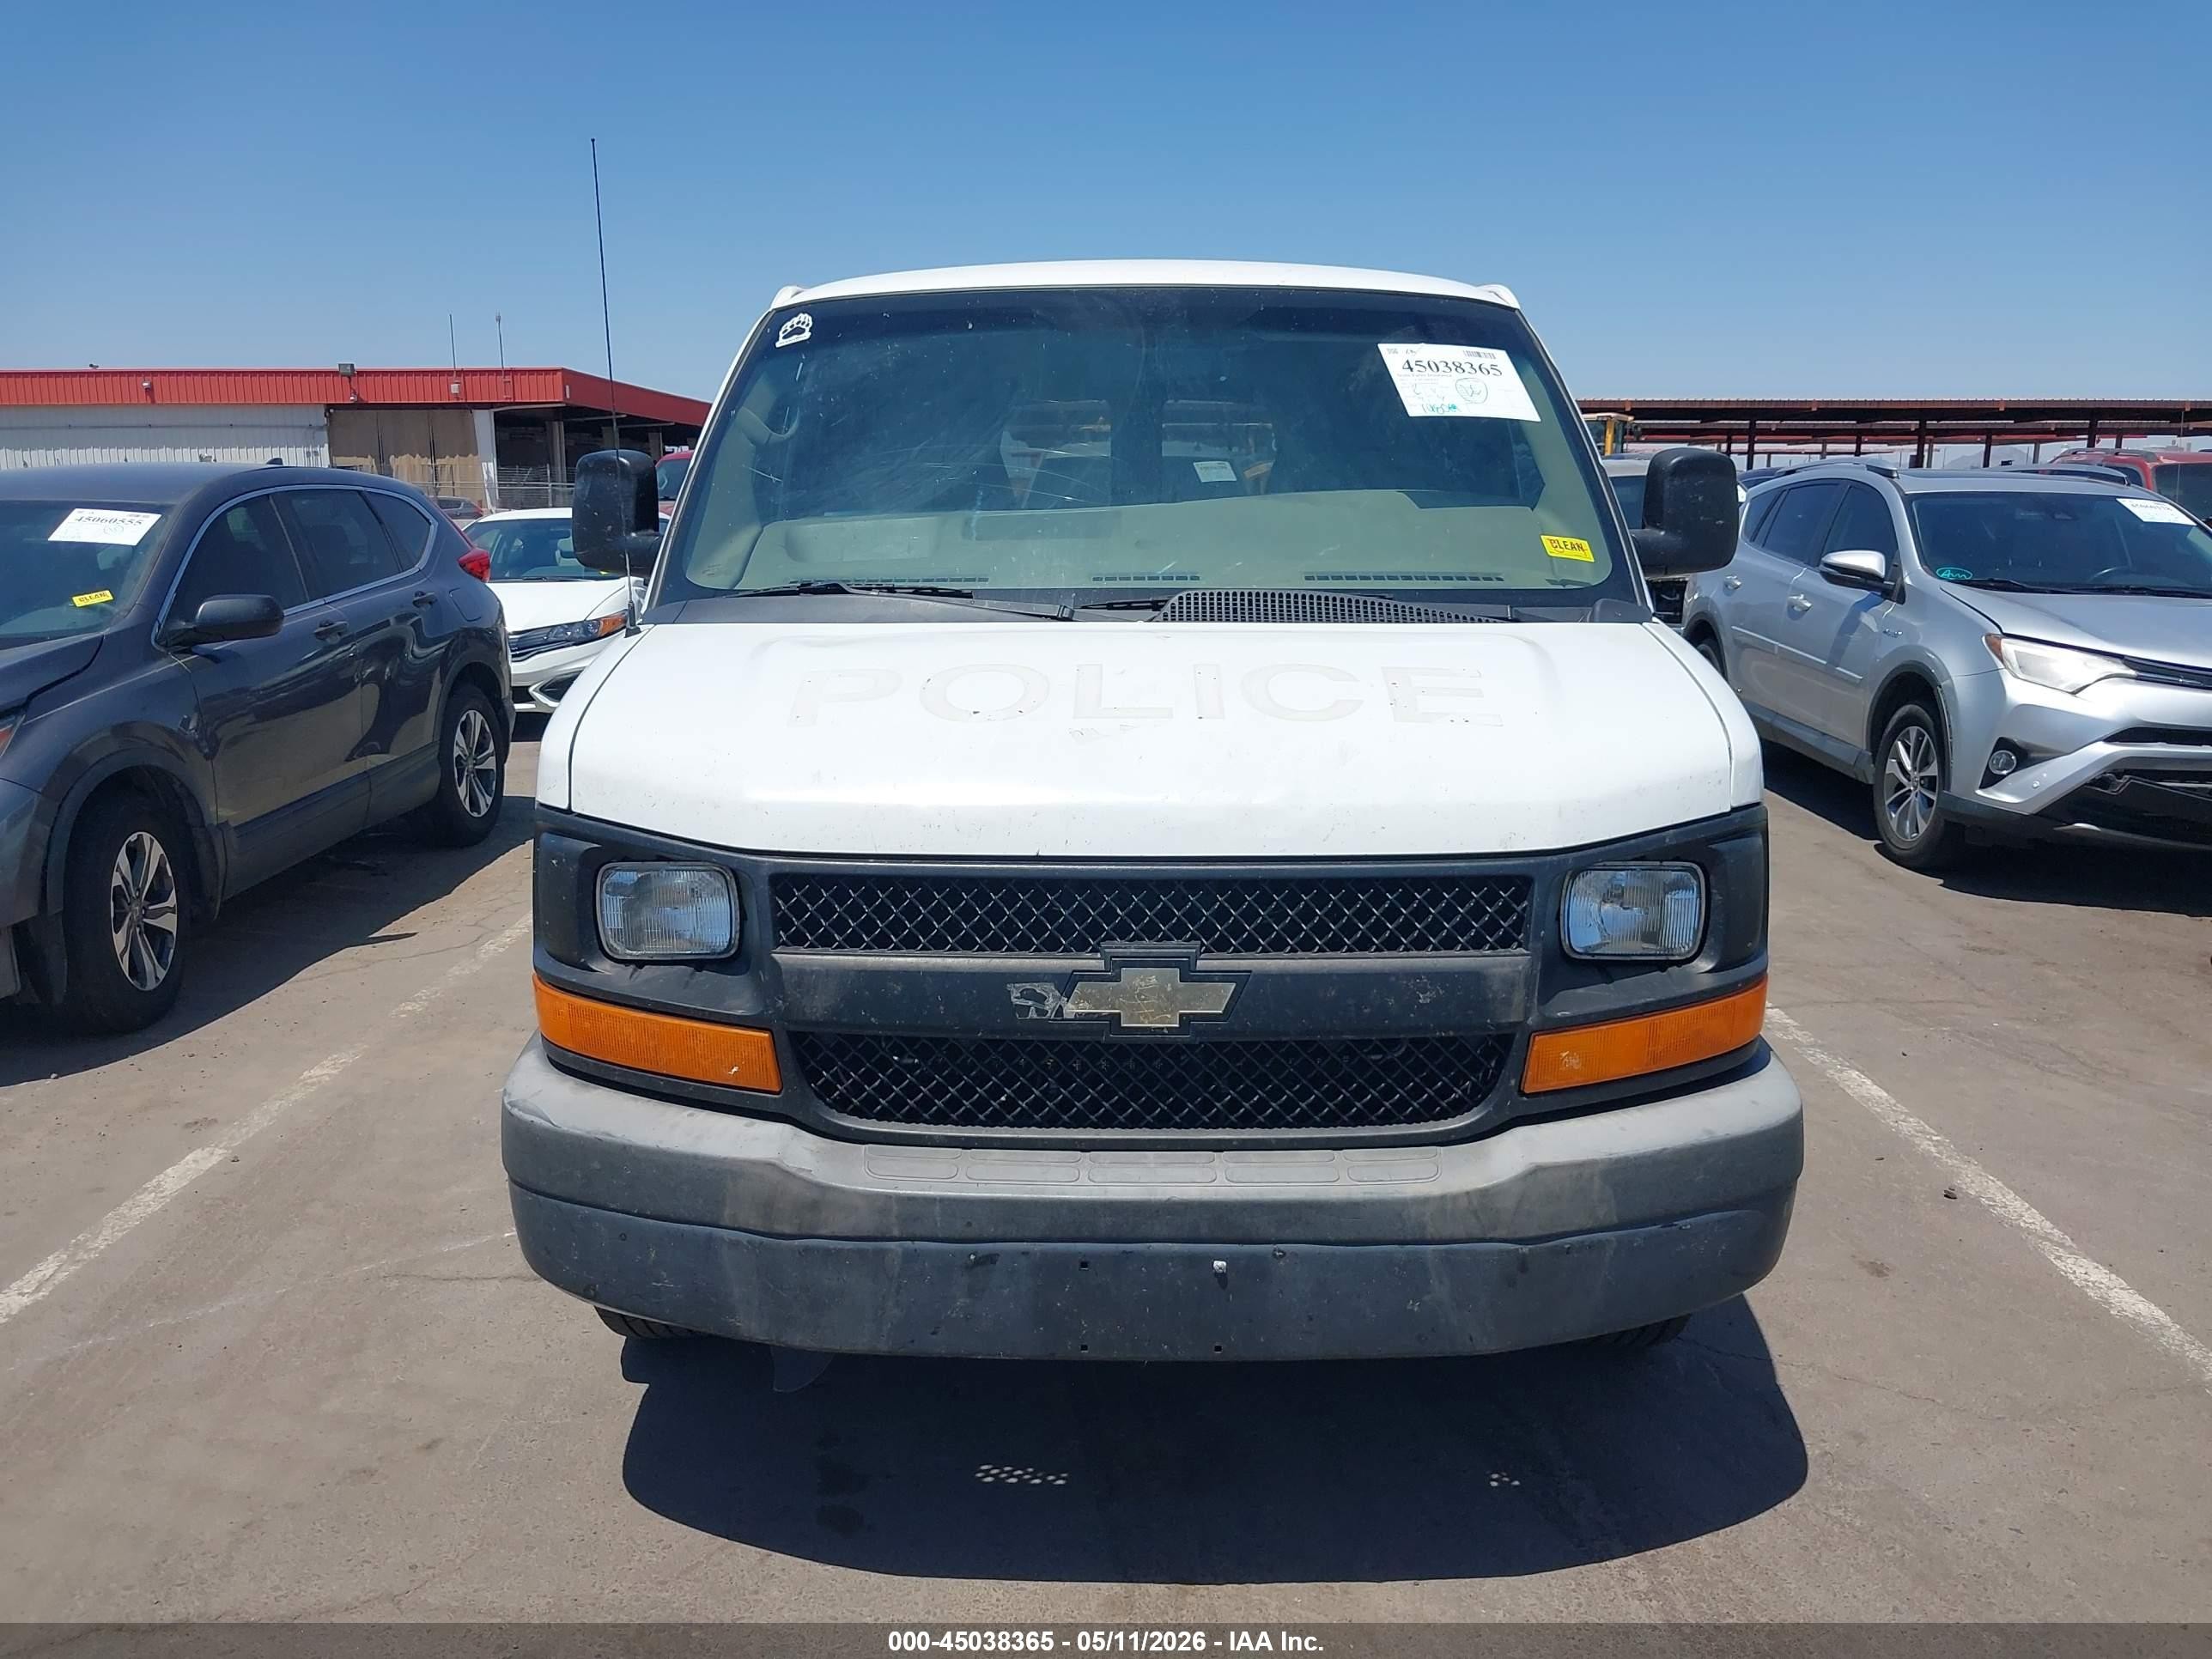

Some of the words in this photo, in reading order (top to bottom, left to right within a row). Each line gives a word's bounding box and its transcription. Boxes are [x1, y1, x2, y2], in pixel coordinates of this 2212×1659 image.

[1402, 358, 1503, 377] 45038365
[1548, 538, 1584, 552] CLEAN
[787, 662, 1504, 727] POLICE
